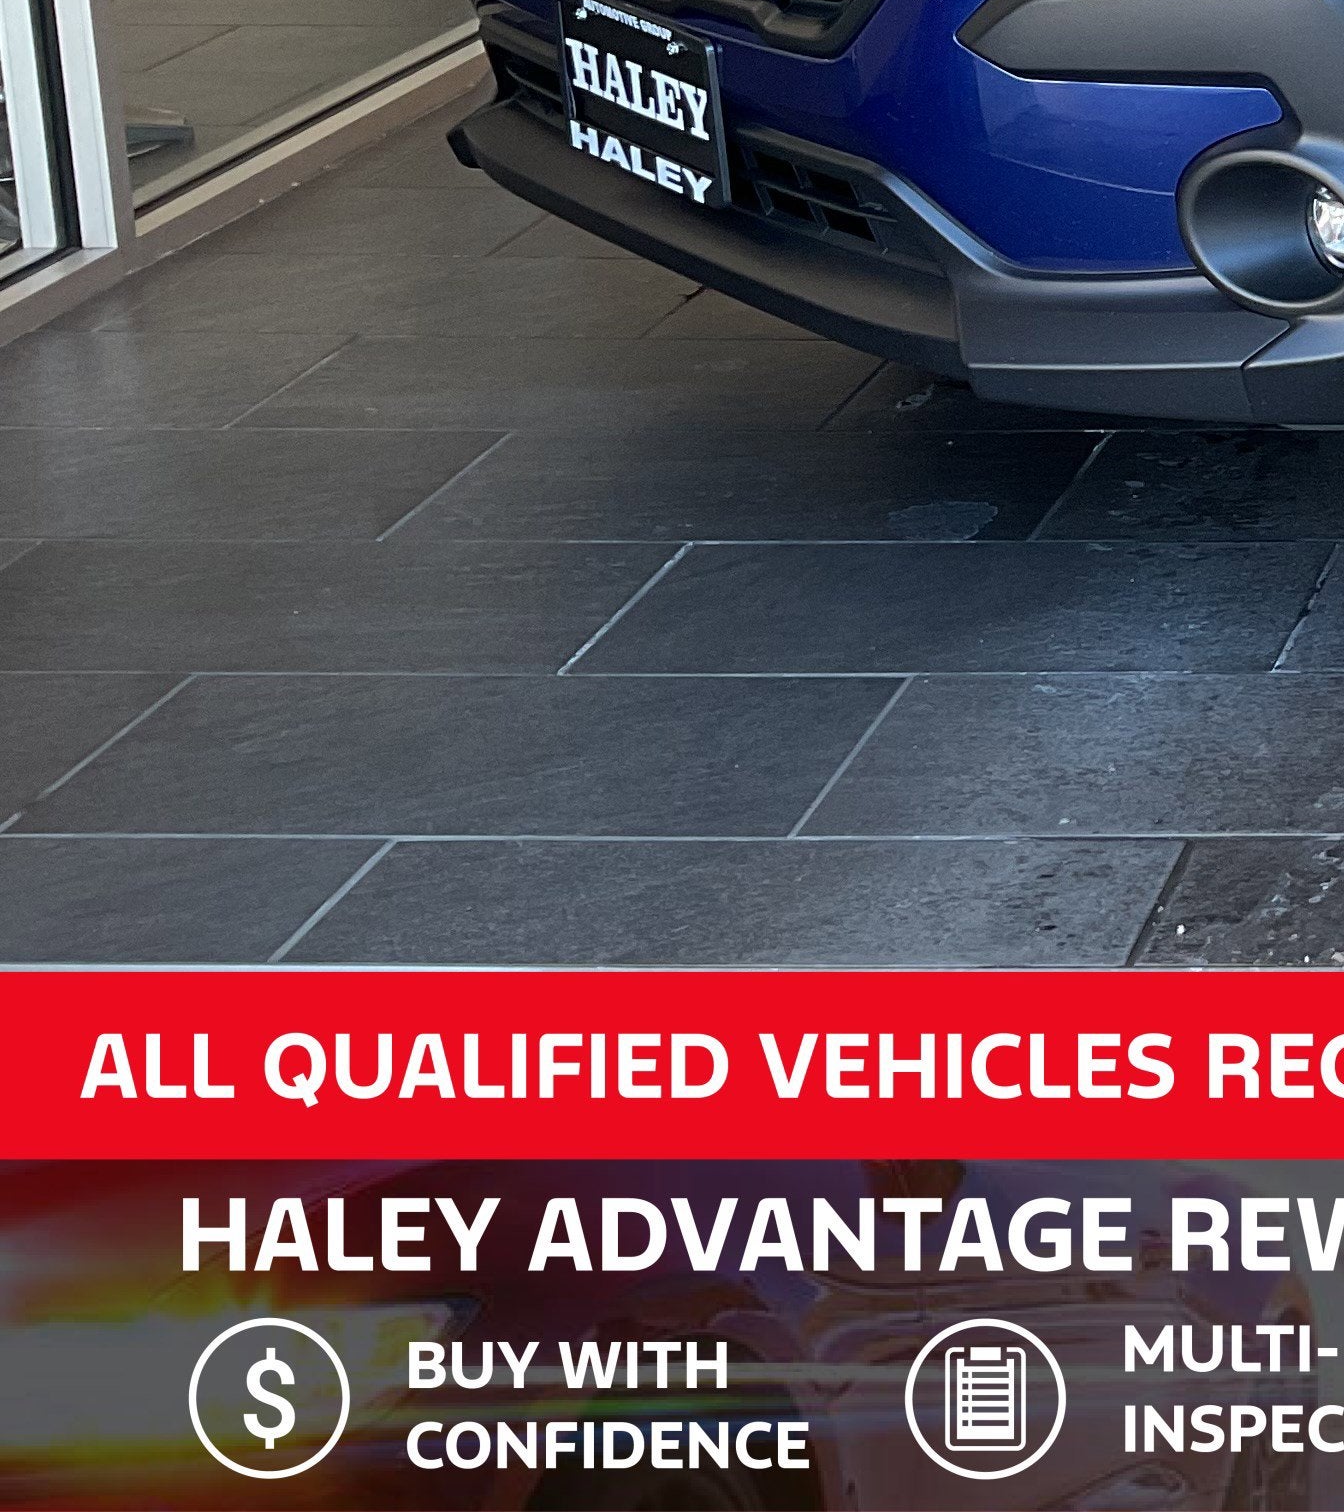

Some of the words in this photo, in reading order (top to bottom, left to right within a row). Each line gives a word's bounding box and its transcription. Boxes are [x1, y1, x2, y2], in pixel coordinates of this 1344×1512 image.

[640, 18, 672, 41] GROUP
[565, 38, 710, 141] HALEY
[570, 119, 713, 204] HALEY
